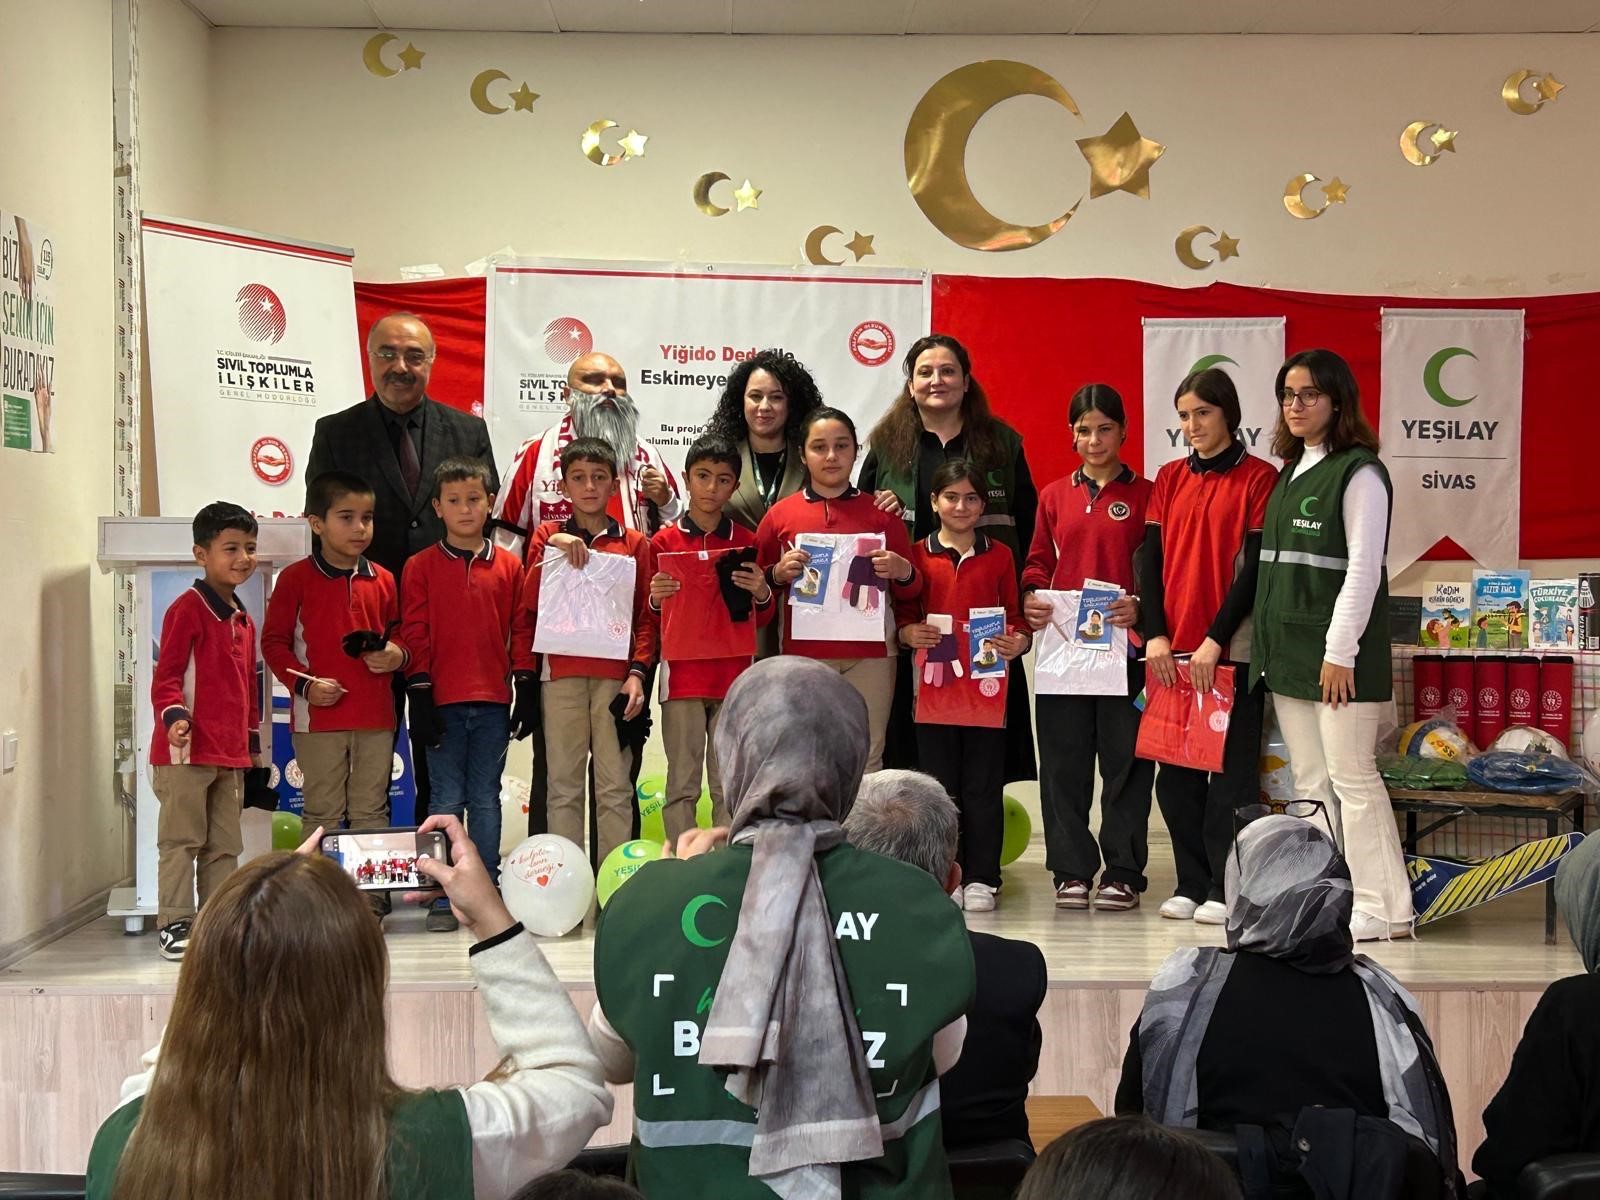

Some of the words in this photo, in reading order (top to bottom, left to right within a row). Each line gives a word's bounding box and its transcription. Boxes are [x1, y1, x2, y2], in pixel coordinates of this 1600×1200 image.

[2, 230, 19, 282] BİZ
[36, 292, 54, 350] İÇİN
[659, 344, 716, 364] Yiğido
[722, 346, 757, 362] Ded
[248, 361, 313, 379] TOPLUMLA
[641, 369, 728, 390] Eskimeye
[218, 371, 315, 393] İLİŞKİLER
[219, 389, 251, 399] GENEL
[660, 424, 674, 432] Bu
[1401, 419, 1499, 444] YEŞİLAY
[1421, 469, 1476, 490] SİVAS
[1292, 518, 1322, 530] YEŞİLAY
[1532, 586, 1568, 597] TÜRKİYE
